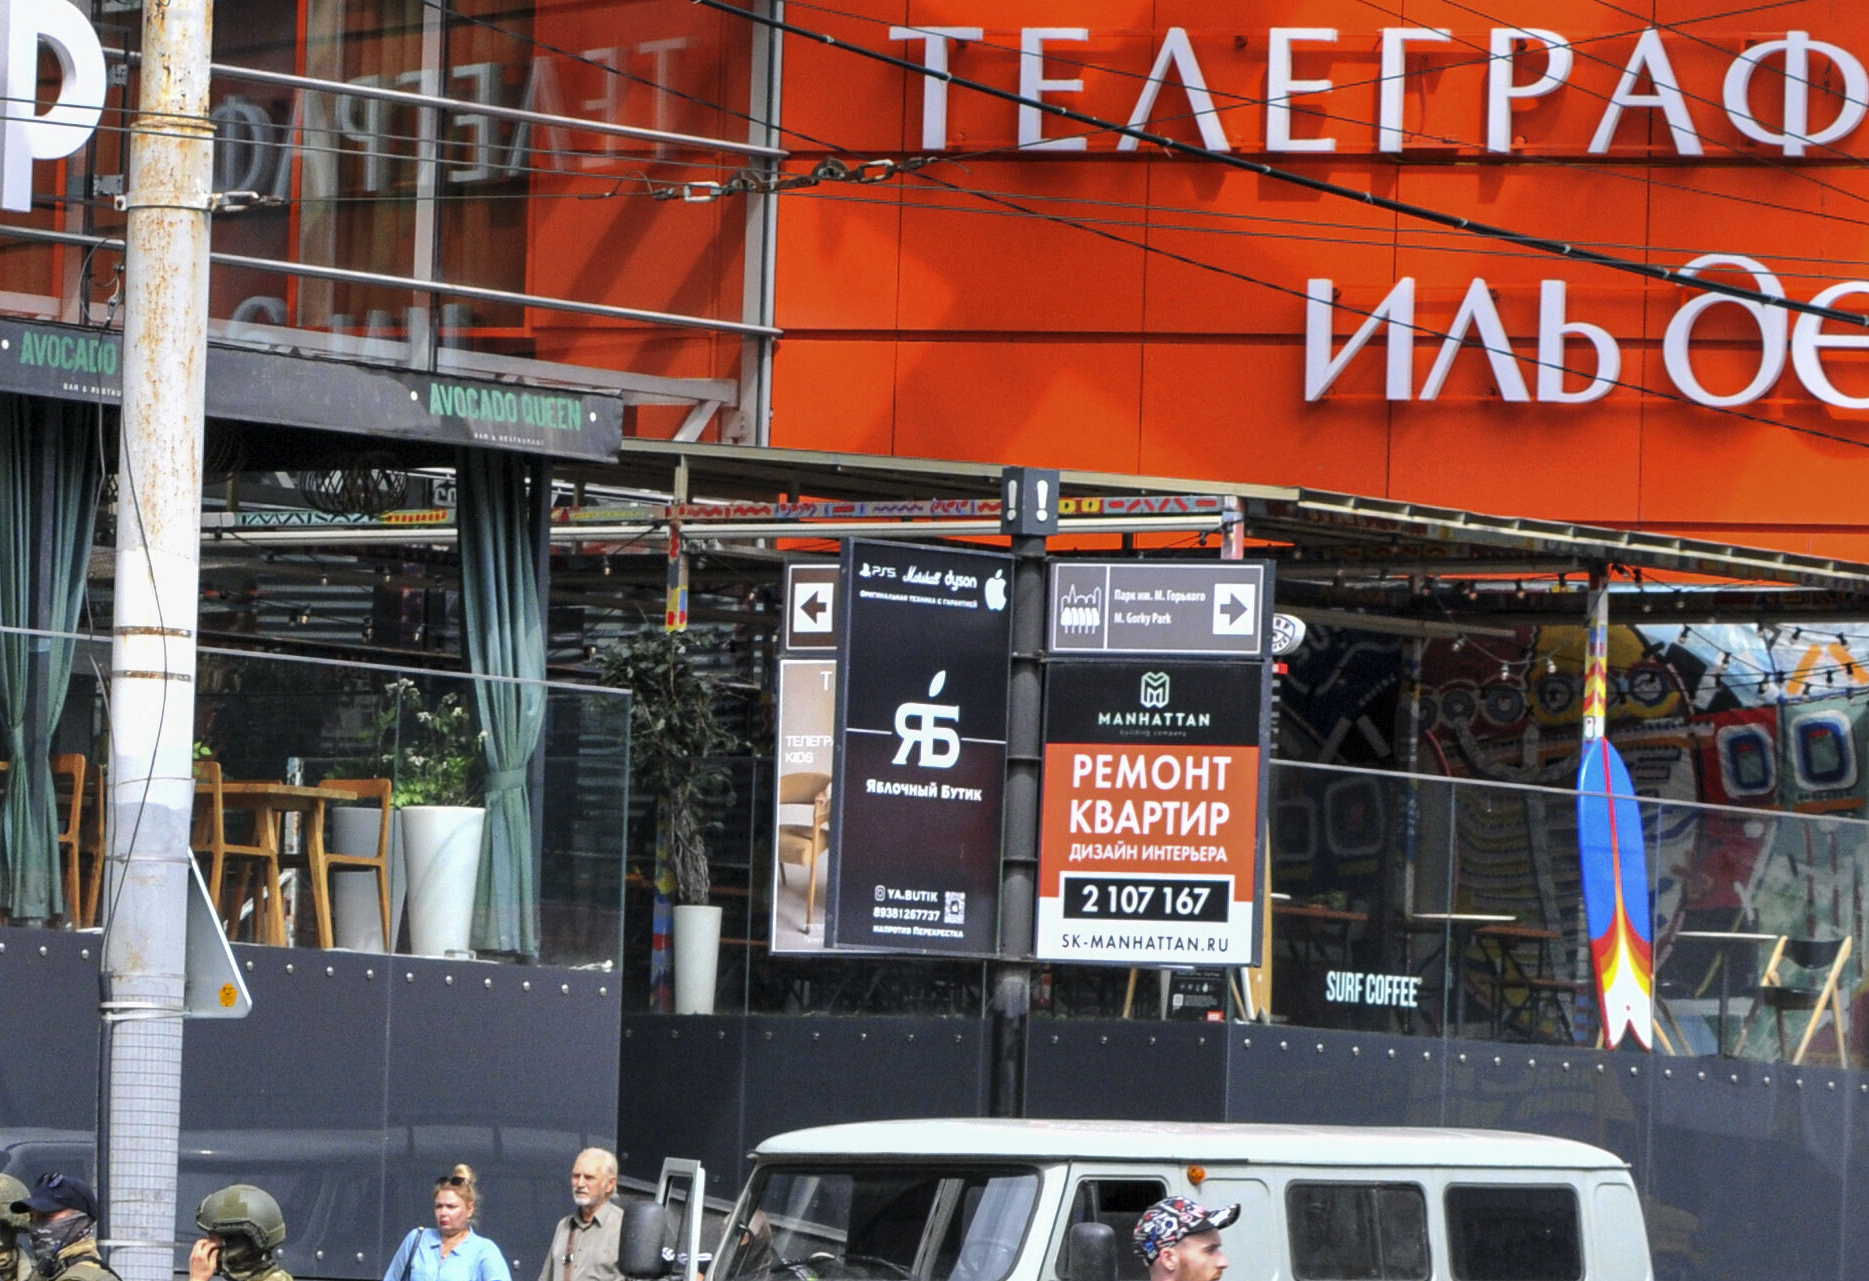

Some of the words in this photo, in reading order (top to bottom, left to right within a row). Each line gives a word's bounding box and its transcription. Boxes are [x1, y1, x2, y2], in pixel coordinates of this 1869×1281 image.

[888, 26, 1869, 158] ТЕЛЕГРАФ
[20, 331, 117, 375] AVOCADO
[430, 382, 518, 424] AVOCADO
[522, 393, 581, 431] QUEEN
[944, 569, 978, 592] dyson
[1114, 589, 1135, 602] Парк
[1167, 589, 1206, 602] Горького
[1127, 612, 1150, 626] Gorky
[1152, 612, 1172, 624] Park
[1098, 711, 1211, 727] MANHATTAN
[785, 751, 814, 764] KIDS
[1072, 753, 1232, 791] РЕМОНТ
[1069, 799, 1230, 836] КВАРТИР
[1068, 840, 1138, 862] ДИЗАЙН
[1141, 845, 1228, 863] ИНТЕРЬЕРА
[887, 888, 938, 902] YA.BUTIK
[1082, 885, 1099, 912] 2
[1107, 885, 1156, 914] 107
[1162, 886, 1211, 915] 167
[1061, 934, 1229, 952] SK-MANHATTAN.RU
[1325, 970, 1364, 1004] SURF
[1365, 973, 1420, 1008] COFFEE
